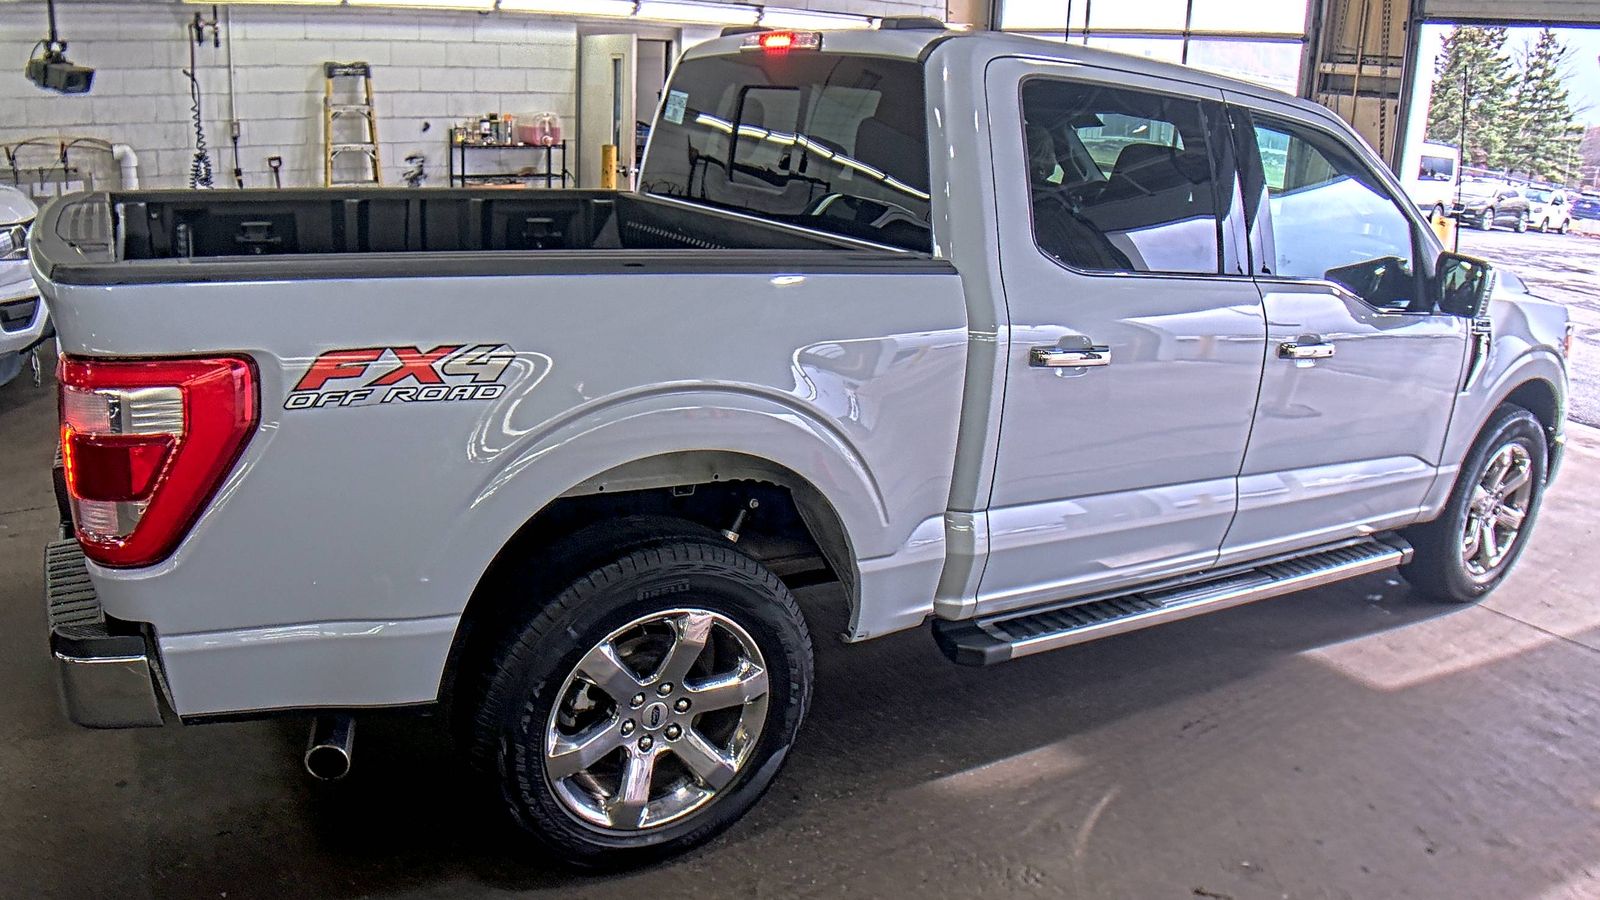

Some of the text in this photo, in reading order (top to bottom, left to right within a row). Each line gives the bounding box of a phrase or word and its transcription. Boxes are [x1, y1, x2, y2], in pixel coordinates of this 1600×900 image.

[291, 344, 516, 391] FX4
[284, 384, 506, 410] OFF ROAD
